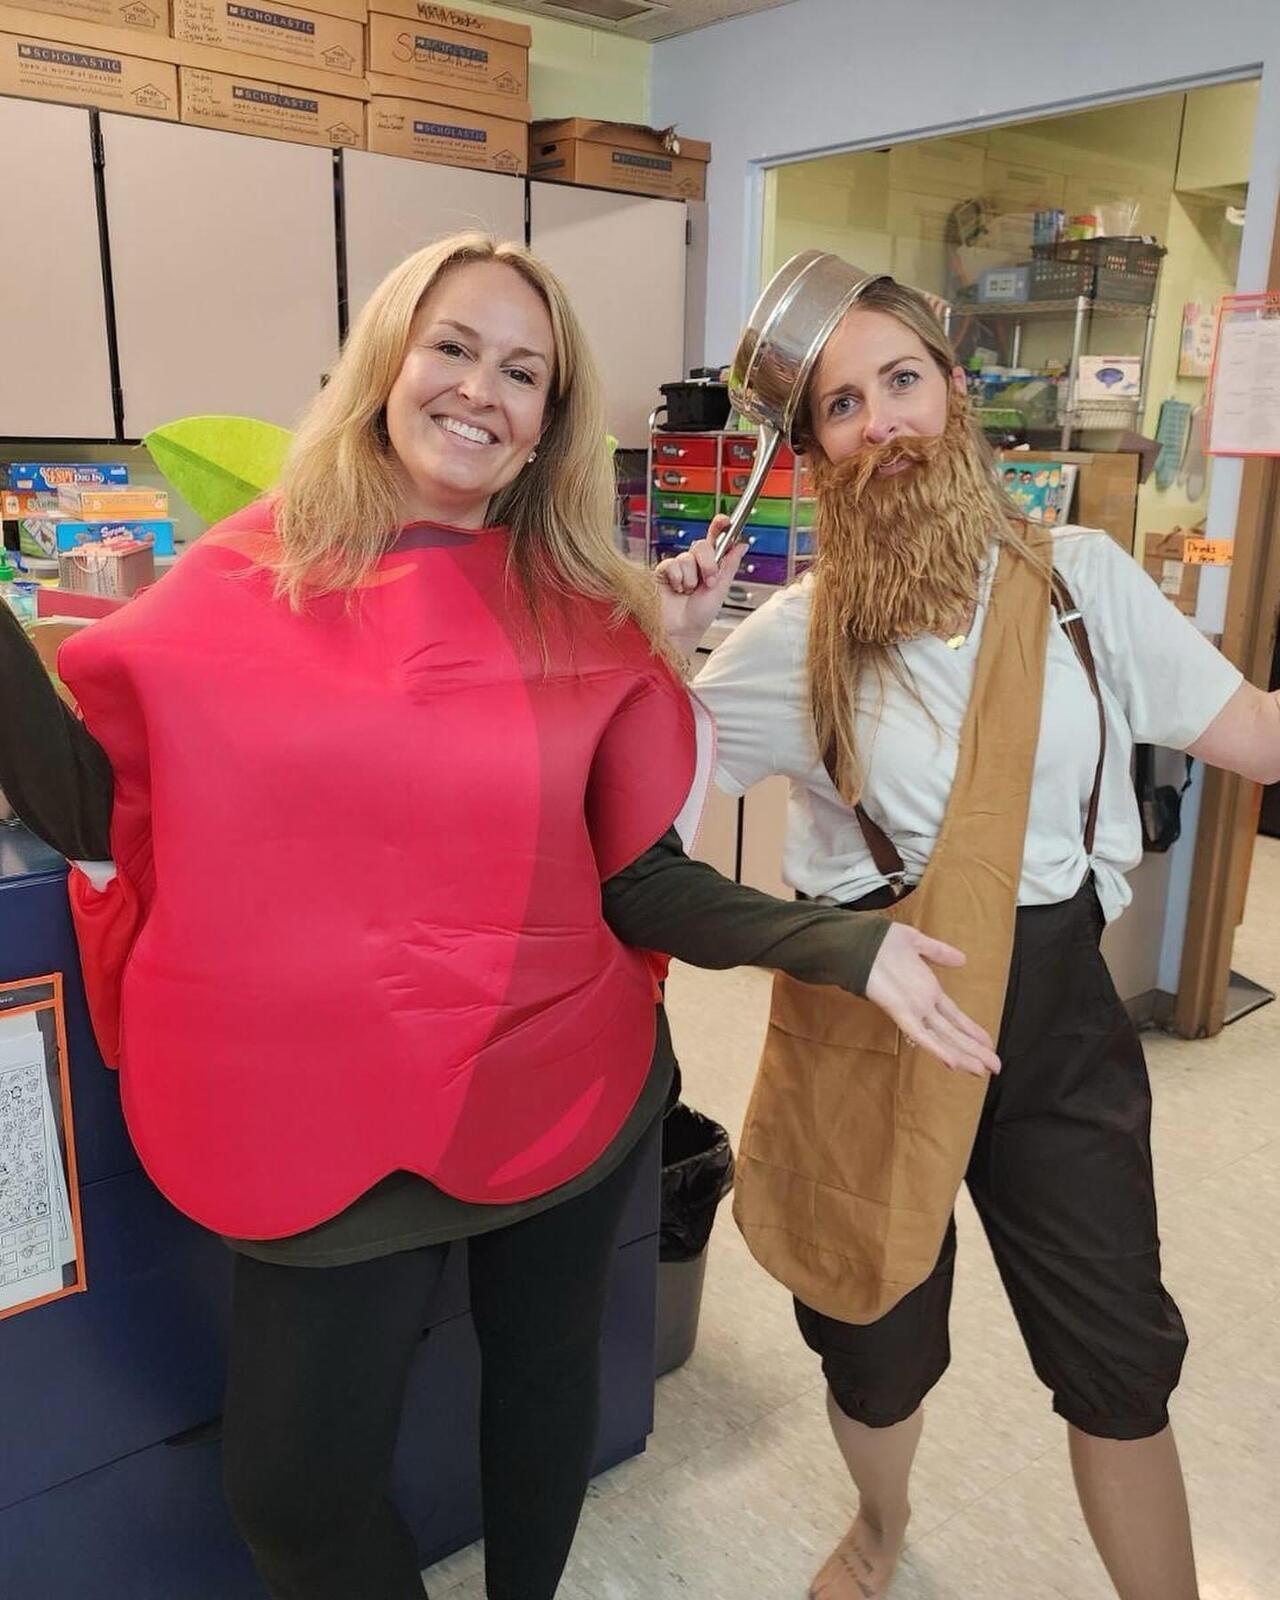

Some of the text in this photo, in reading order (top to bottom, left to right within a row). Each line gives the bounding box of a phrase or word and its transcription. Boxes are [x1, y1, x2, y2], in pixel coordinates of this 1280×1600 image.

[240, 8, 313, 32] SCHOLASTIC
[33, 47, 120, 71] SCHOLASTIC
[244, 90, 317, 111] SCHOLASTIC
[424, 124, 485, 140] SCHOLASTIC
